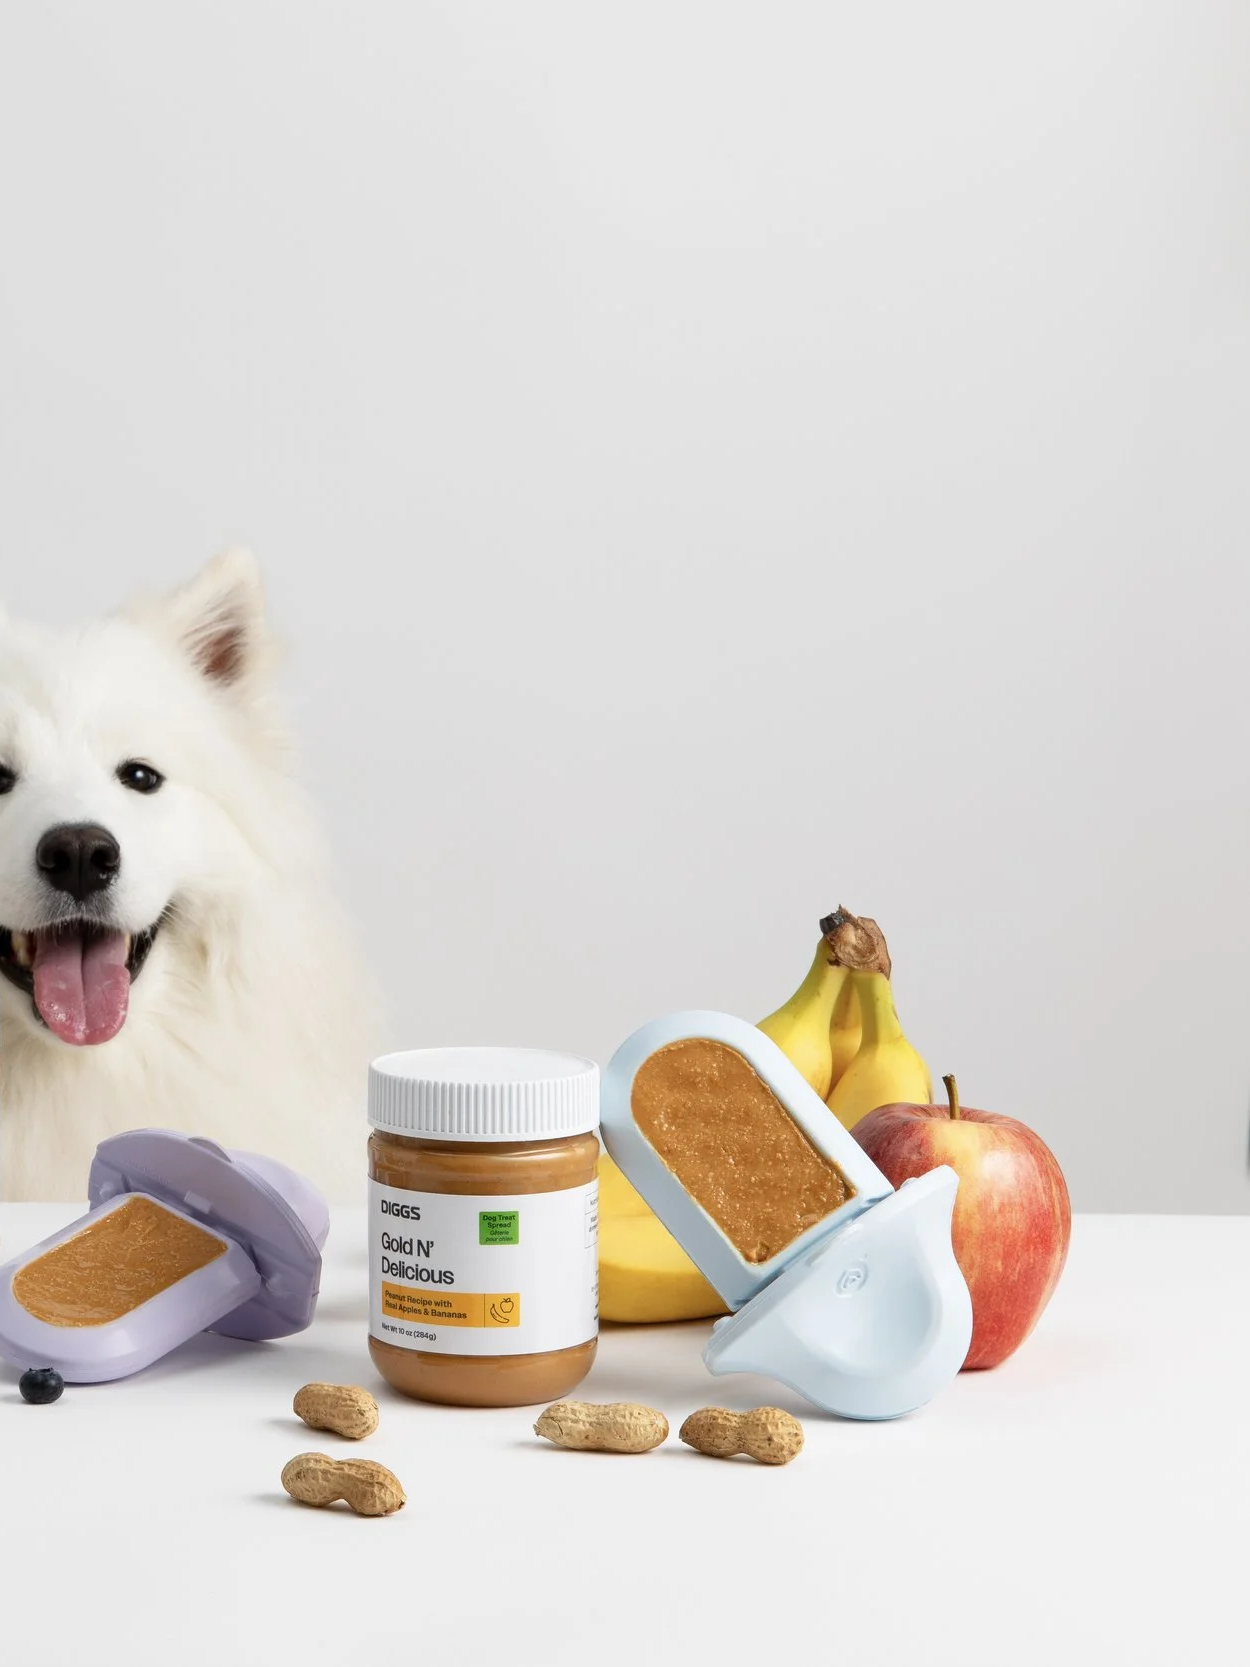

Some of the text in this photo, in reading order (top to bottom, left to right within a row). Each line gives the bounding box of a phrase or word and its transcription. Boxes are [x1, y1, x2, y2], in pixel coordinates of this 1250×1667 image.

[381, 1200, 420, 1220] DIGGS
[382, 1232, 413, 1256] Gold
[382, 1256, 454, 1285] Delicious
[385, 1290, 406, 1301] Peanut
[408, 1296, 432, 1307] Recipe
[385, 1300, 397, 1309] Real
[399, 1304, 422, 1314] Apples
[431, 1309, 467, 1319] Bananas
[390, 1325, 397, 1333] Wt
[414, 1329, 436, 1341] (284g)
